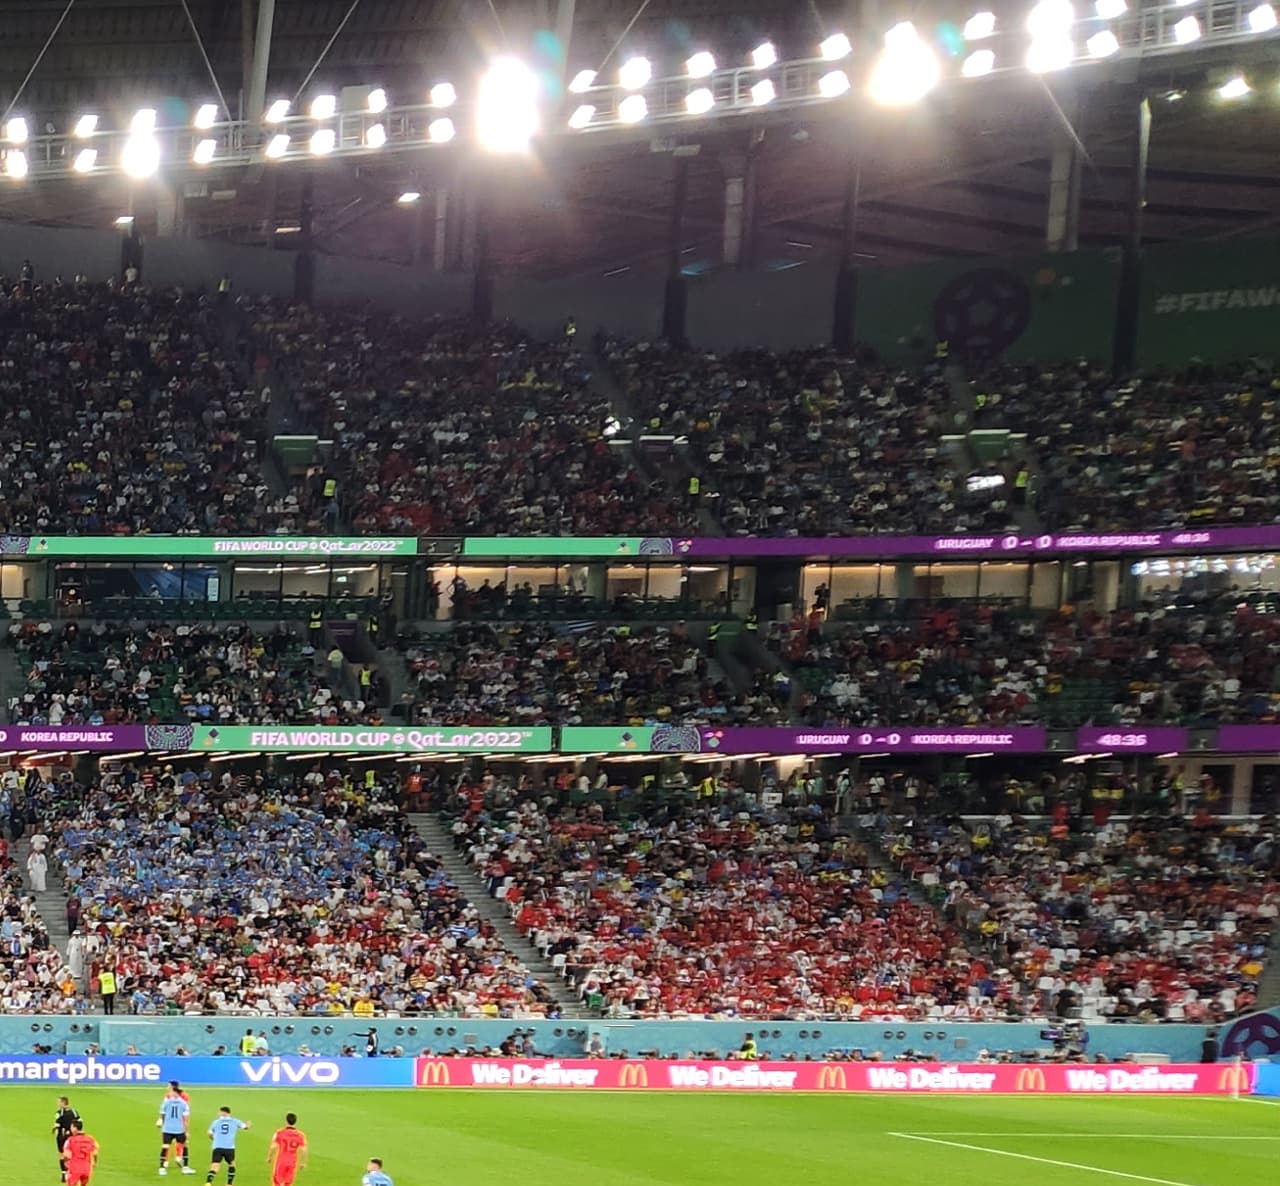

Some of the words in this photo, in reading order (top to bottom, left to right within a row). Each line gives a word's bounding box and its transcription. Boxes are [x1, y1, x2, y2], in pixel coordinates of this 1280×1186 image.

[214, 541, 240, 552] FIFA
[241, 541, 283, 552] WORLD
[284, 541, 308, 552] CUP
[935, 538, 994, 549] URUGUAY
[1056, 536, 1101, 548] KOREA
[1102, 534, 1161, 547] REPUBLIC
[21, 731, 57, 742] KOREA
[58, 731, 113, 742] REPUBLIC
[251, 731, 288, 746] FIFA
[289, 731, 352, 746] WORLD
[354, 731, 390, 746] CUP
[797, 735, 849, 745] URUGUAY
[858, 734, 872, 745] 0
[886, 734, 901, 745] 0
[912, 735, 953, 745] KOREA
[954, 735, 1013, 745] REPUBLIC
[241, 1057, 339, 1082] vivo
[472, 1064, 510, 1085] We
[513, 1062, 597, 1085] Deliver
[670, 1065, 709, 1087] We
[712, 1064, 796, 1088] Deliver
[868, 1066, 908, 1088] We
[911, 1064, 996, 1090] Deliver
[1067, 1067, 1108, 1090] We
[1111, 1066, 1197, 1091] Deliver
[171, 1106, 178, 1118] 11
[220, 1124, 230, 1134] 9
